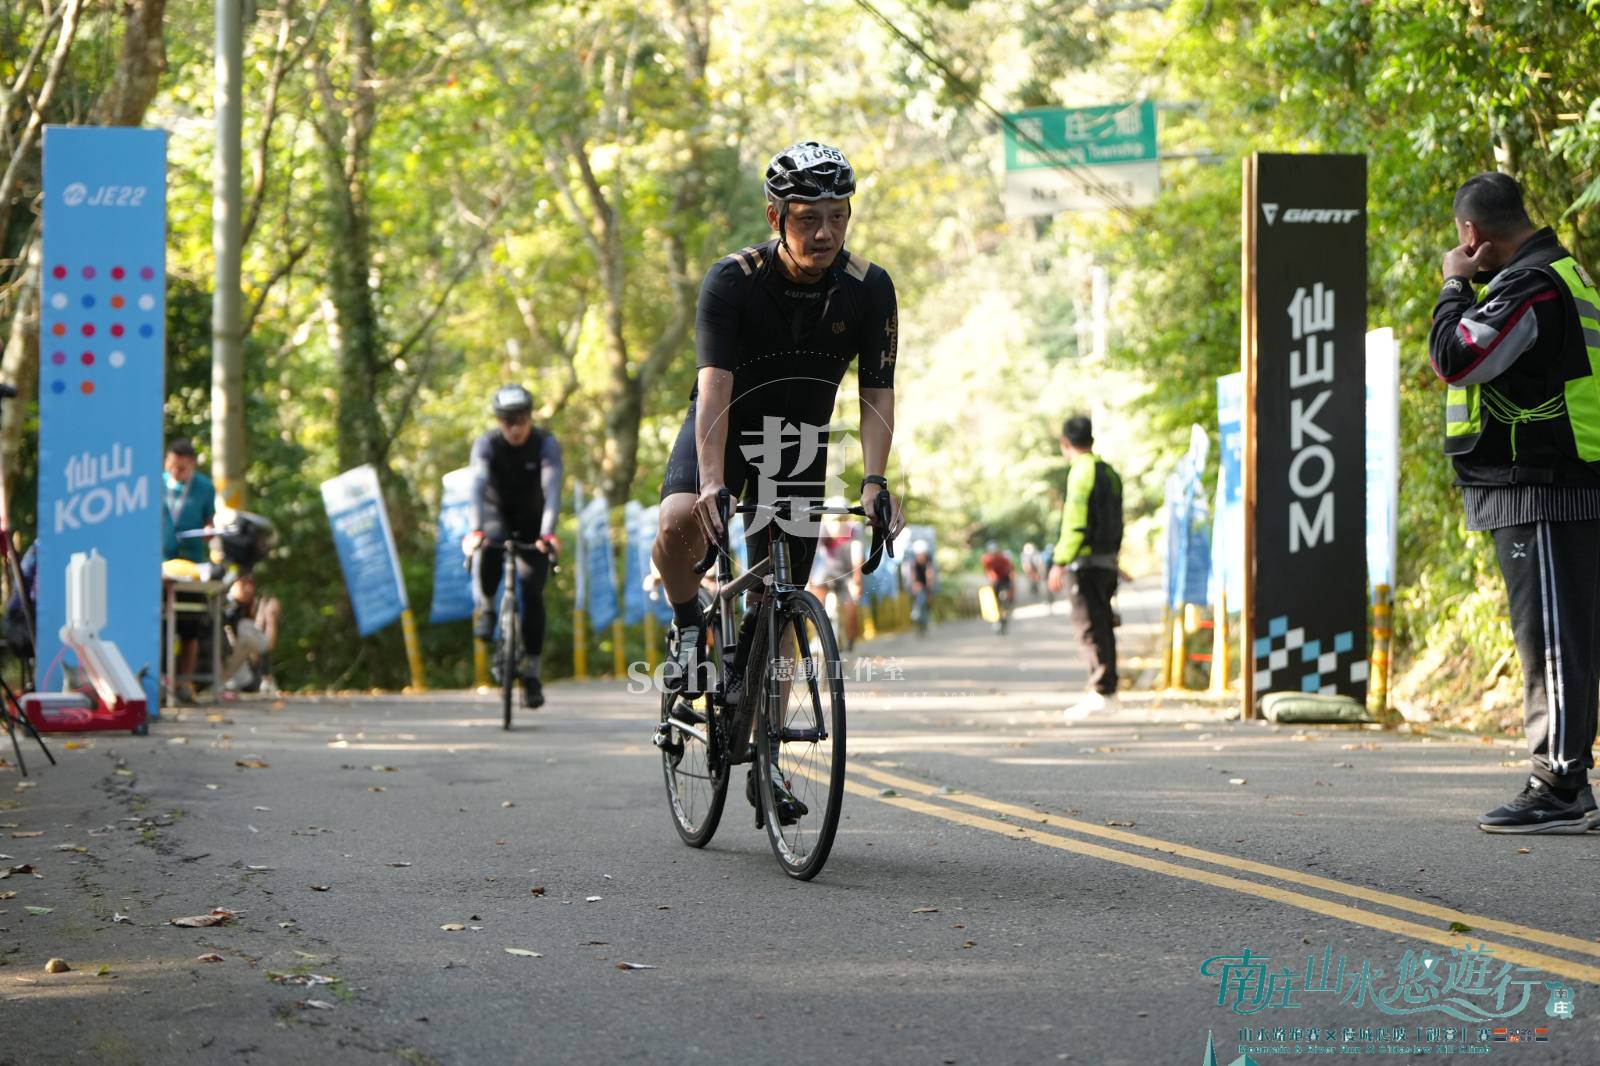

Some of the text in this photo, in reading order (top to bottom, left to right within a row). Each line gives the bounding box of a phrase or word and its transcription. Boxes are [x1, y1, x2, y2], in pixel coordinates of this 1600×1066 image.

[87, 185, 147, 206] JE22
[1282, 208, 1360, 224] GIANT
[64, 442, 133, 493] 仙山
[54, 475, 149, 534] KOM
